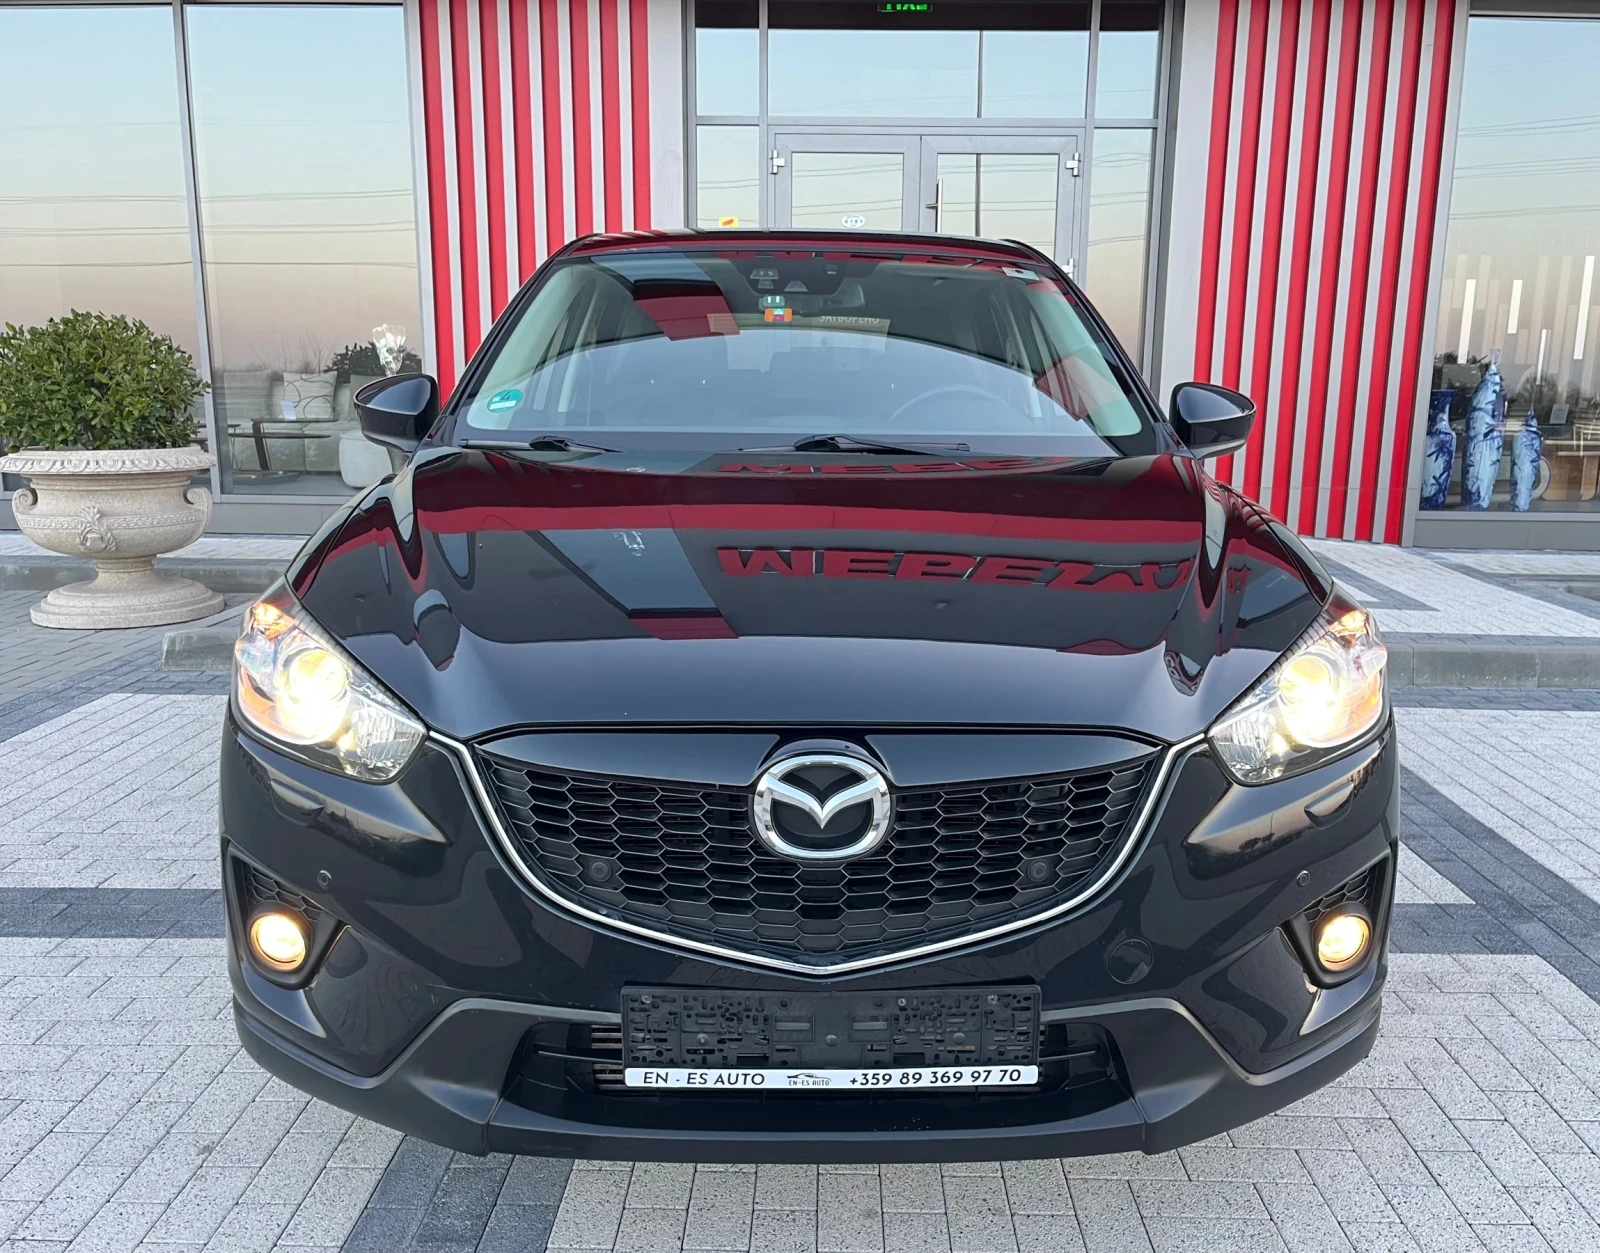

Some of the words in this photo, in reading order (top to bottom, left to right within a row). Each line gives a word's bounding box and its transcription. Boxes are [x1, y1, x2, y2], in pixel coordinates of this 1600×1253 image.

[643, 1071, 669, 1084] EN
[686, 1072, 709, 1085] ES
[713, 1073, 765, 1086] AUTO
[849, 1072, 893, 1086] +359
[899, 1071, 923, 1085] 89
[929, 1071, 964, 1084] 369
[970, 1070, 993, 1083] 97
[998, 1068, 1022, 1082] 70
